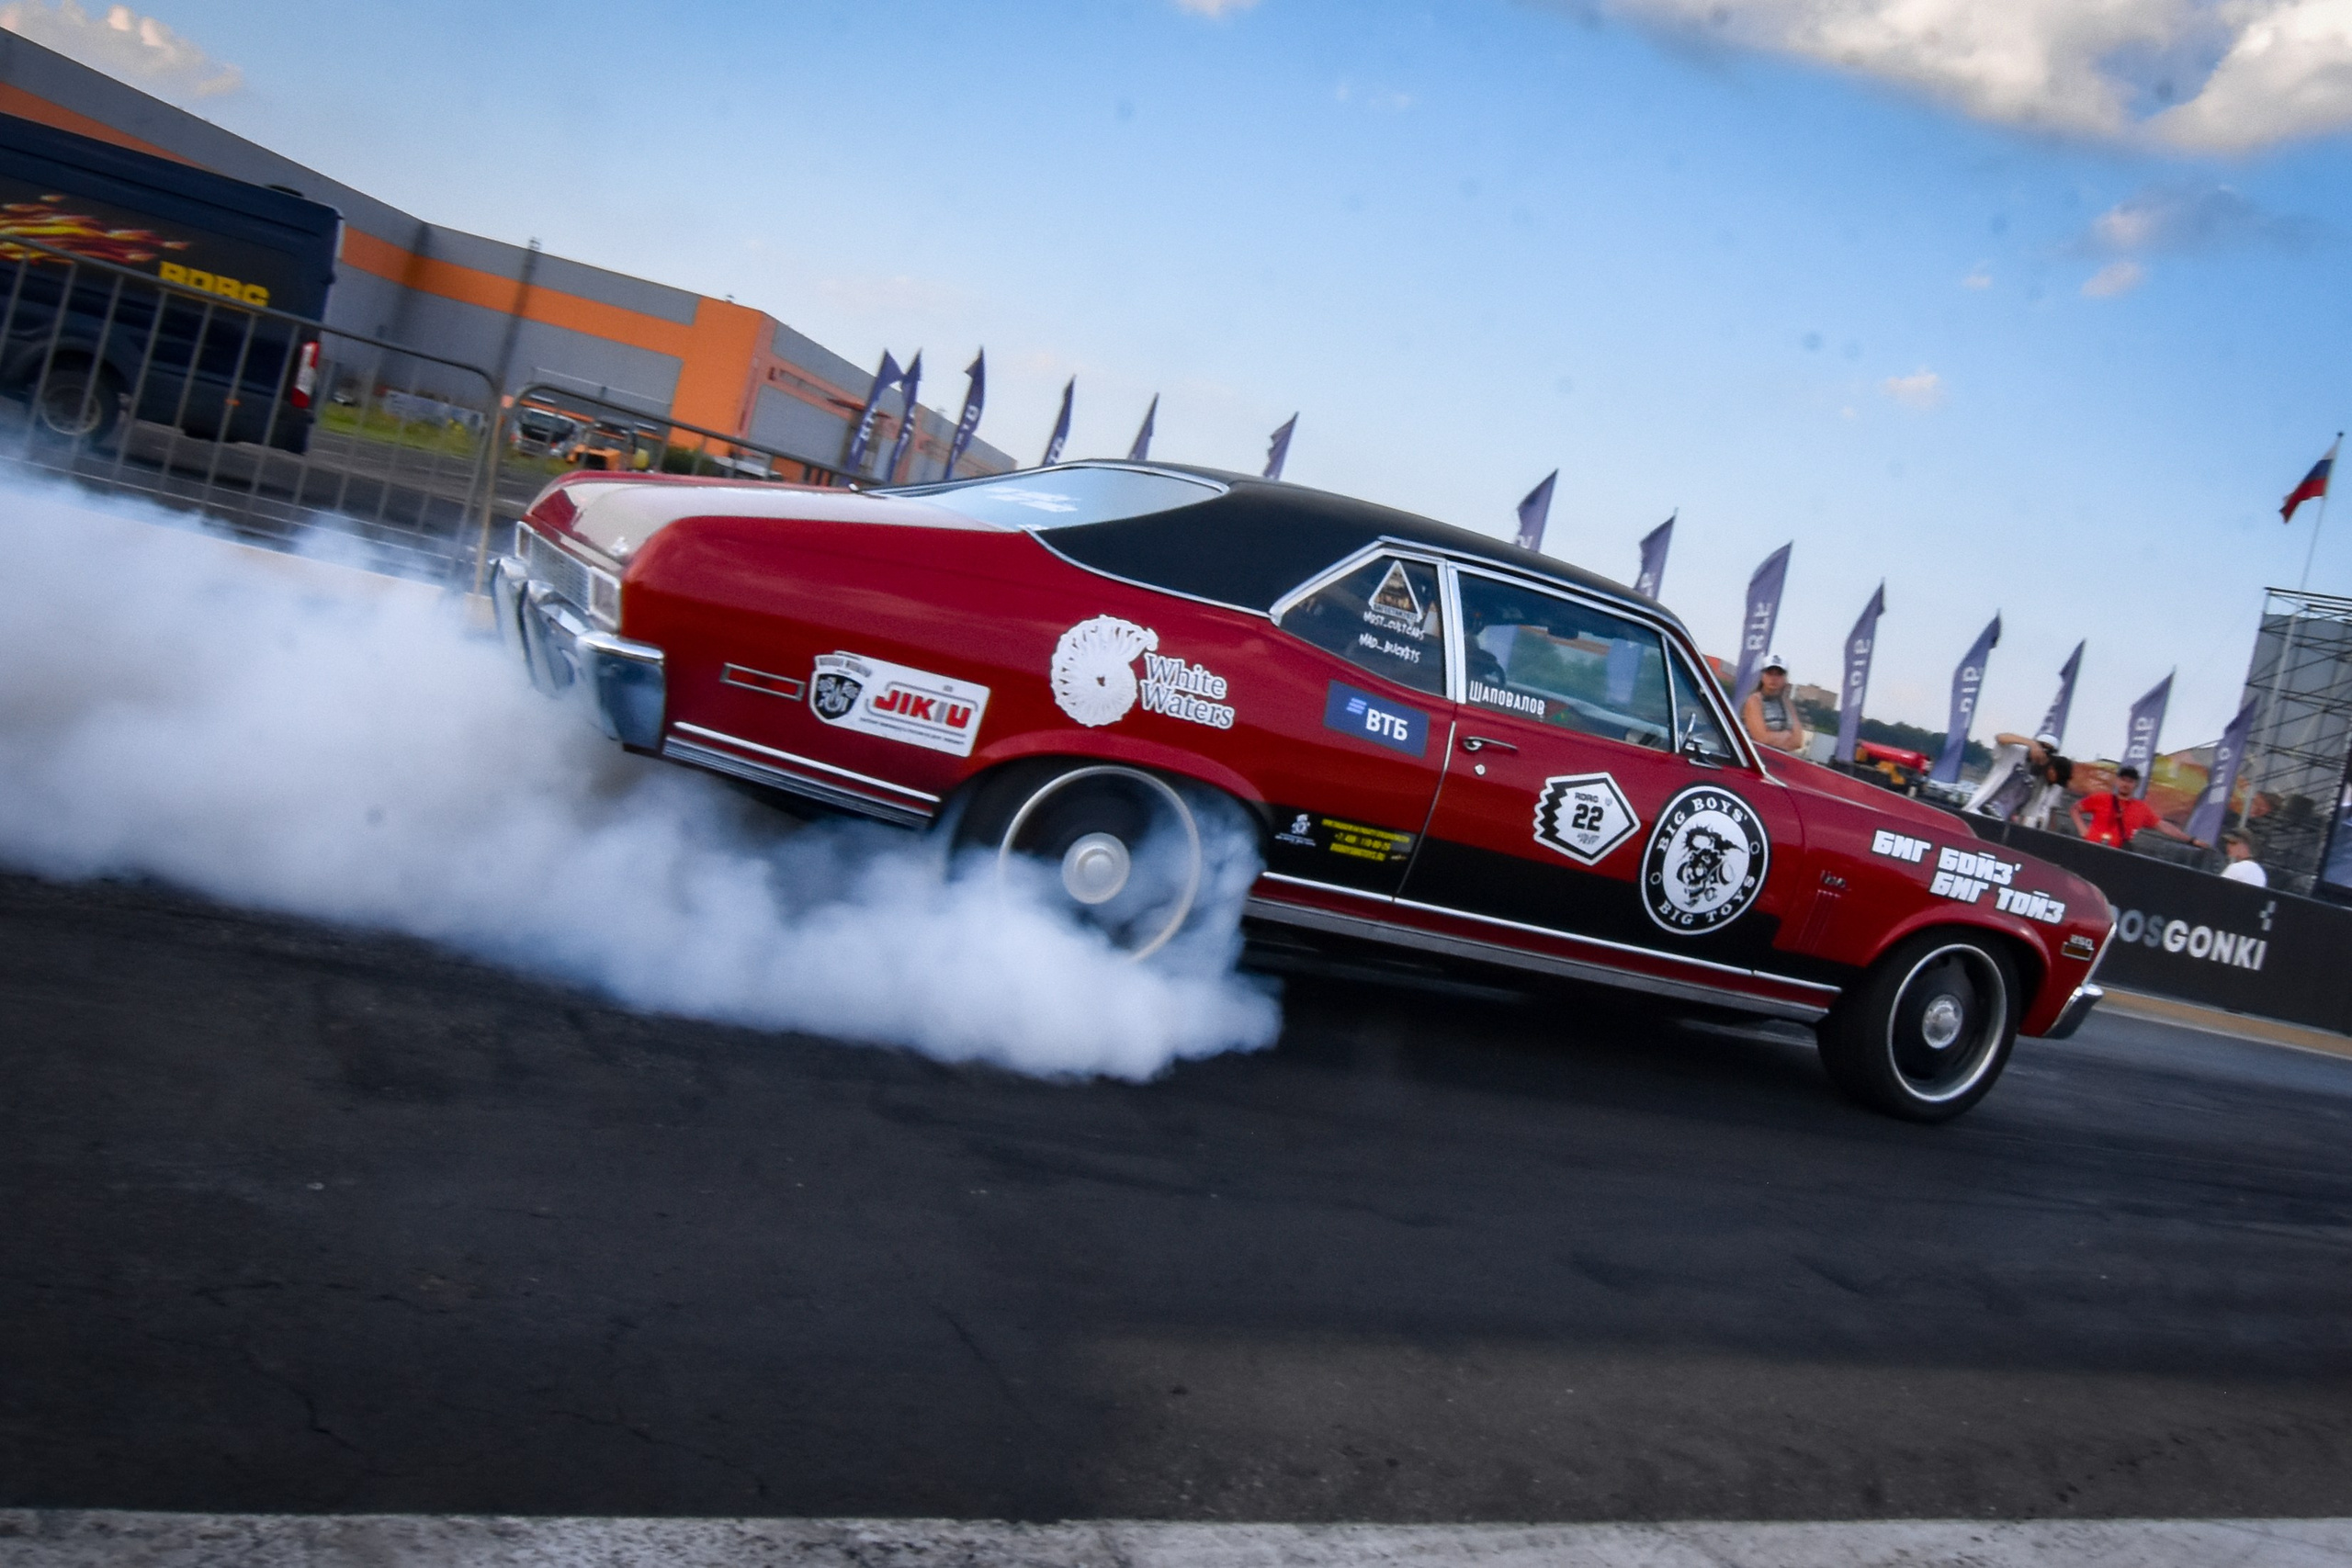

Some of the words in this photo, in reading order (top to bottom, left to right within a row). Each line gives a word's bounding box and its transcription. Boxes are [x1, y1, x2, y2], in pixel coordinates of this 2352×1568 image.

[1146, 654, 1226, 697] White
[874, 689, 972, 729] JIKIU
[1142, 682, 1233, 727] Waters
[1365, 708, 1409, 741] ВТБ
[1572, 803, 1604, 831] 22
[1657, 809, 1686, 852] BIG
[1871, 829, 1932, 863] БИГ
[1657, 899, 1695, 925] BIG
[1706, 874, 1756, 923] TOYS
[1929, 871, 1990, 903] БИГ
[1996, 886, 2066, 924] ТОЙЗ
